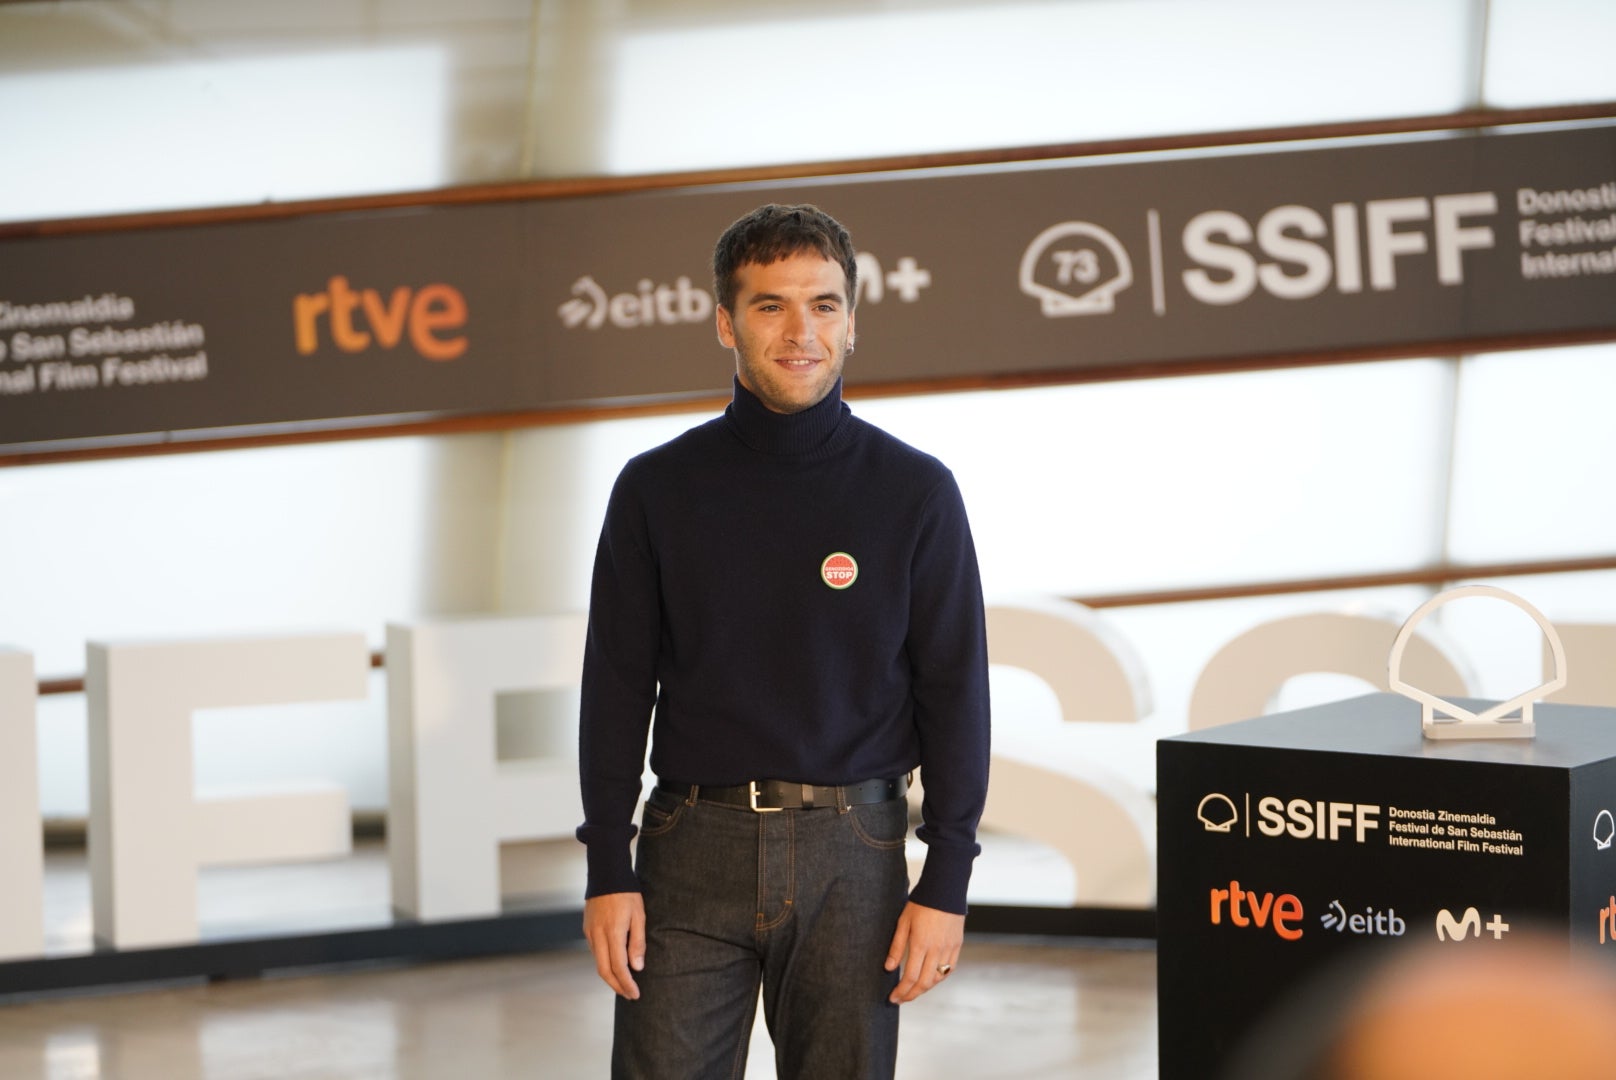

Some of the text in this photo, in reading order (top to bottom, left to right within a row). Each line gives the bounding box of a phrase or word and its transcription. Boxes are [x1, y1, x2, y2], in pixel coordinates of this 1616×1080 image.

[1052, 249, 1099, 285] 73
[1183, 192, 1497, 306] SSIFF
[293, 275, 468, 361] rtve
[609, 277, 713, 328] eitb
[11, 331, 66, 362] San
[69, 320, 205, 357] Sebastián
[39, 361, 99, 392] Film
[101, 350, 209, 387] Festival
[826, 571, 853, 580] STOP
[1257, 796, 1381, 842] SSIFF
[1389, 806, 1496, 825] Donostia Zinemaldia
[1389, 821, 1522, 841] Festival de San Sebastián
[1389, 835, 1523, 856] International Film Festival
[1210, 880, 1304, 940] rtve
[1349, 906, 1406, 936] eitb
